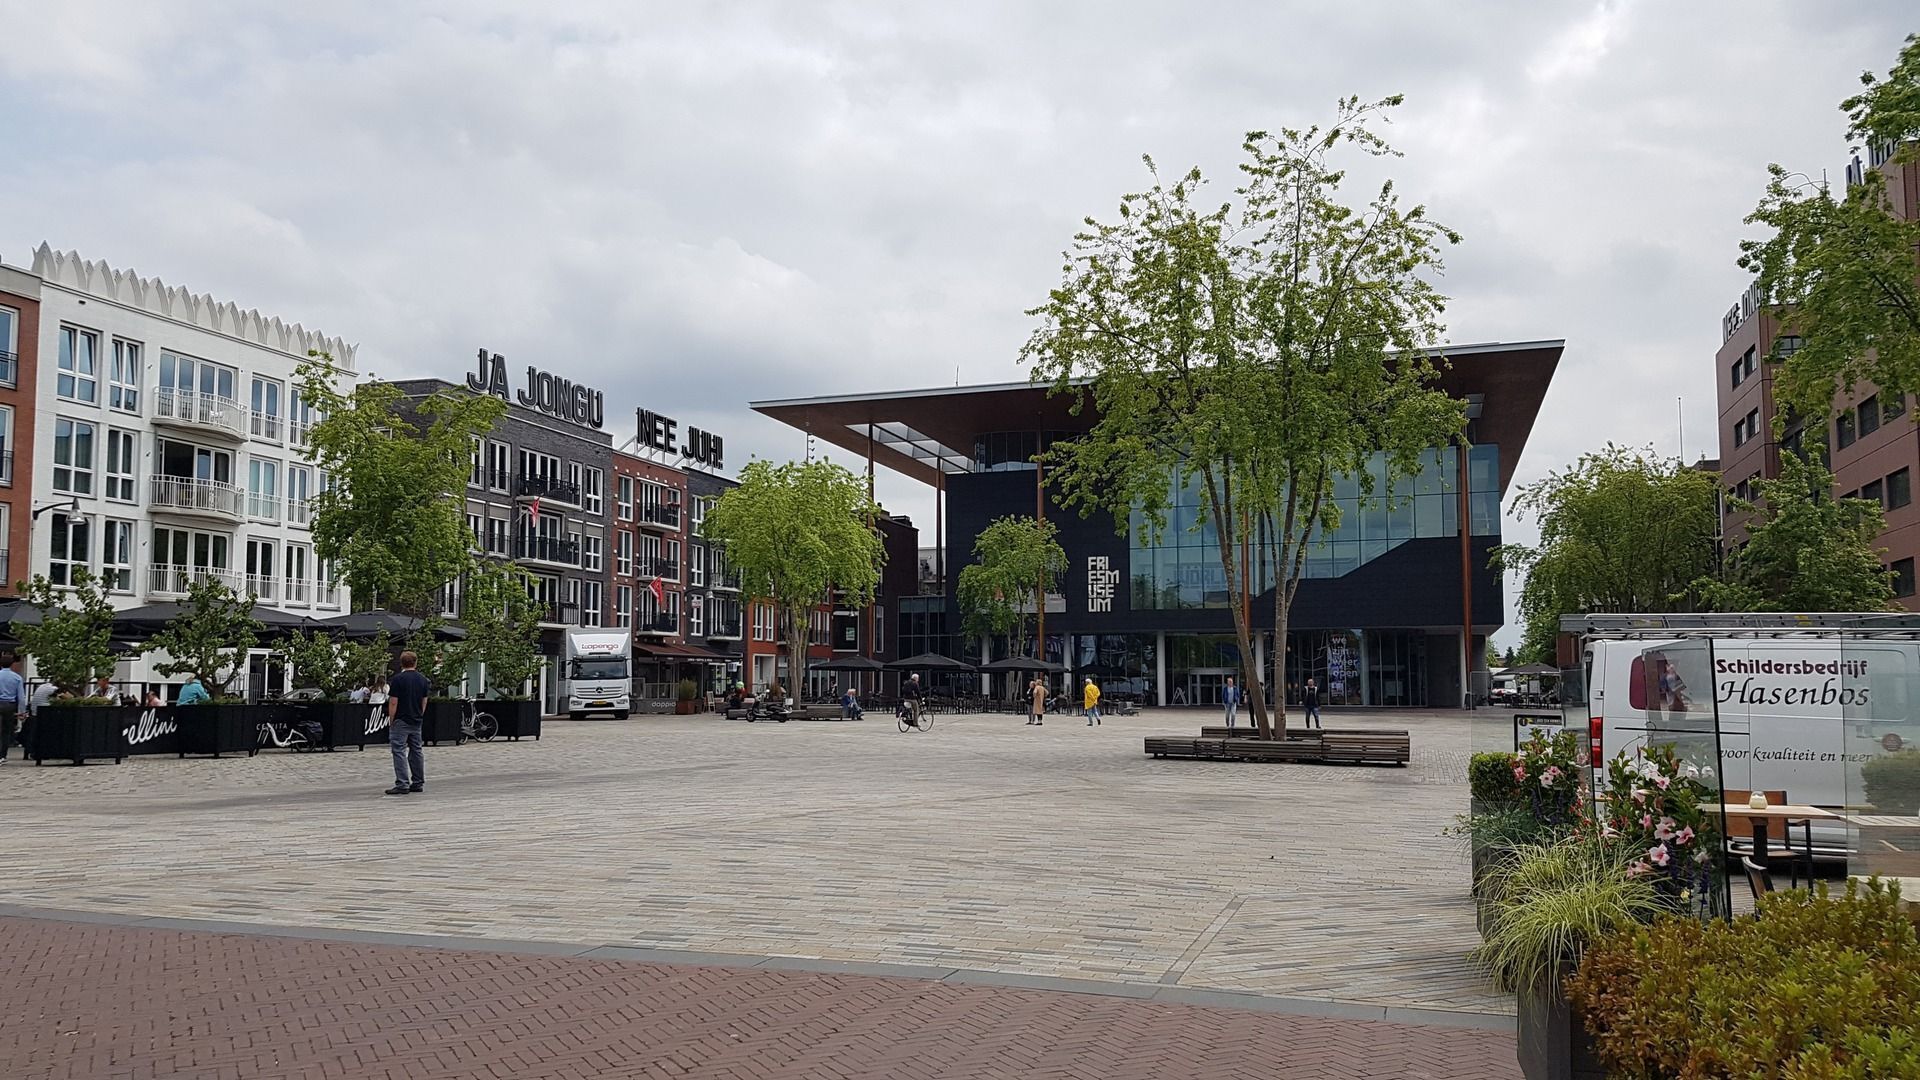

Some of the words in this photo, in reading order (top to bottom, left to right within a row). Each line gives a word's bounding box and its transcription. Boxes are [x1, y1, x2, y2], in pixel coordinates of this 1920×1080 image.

[467, 348, 510, 400] JA
[517, 365, 604, 429] JONGU
[636, 406, 677, 454] NEE
[681, 425, 724, 470] JUH!
[1088, 556, 1109, 570] FRI
[1088, 570, 1120, 584] ESM
[1088, 584, 1115, 598] USE
[1088, 598, 1112, 612] UM
[1332, 669, 1359, 679] open
[1716, 659, 1868, 678] Schildersbedrijf
[1717, 677, 1871, 706] Hasenbos
[122, 708, 178, 745] ellini
[1720, 749, 1750, 760] voor
[1752, 746, 1816, 763] kwaliteit
[1820, 752, 1837, 762] en
[1840, 752, 1873, 763] meer
